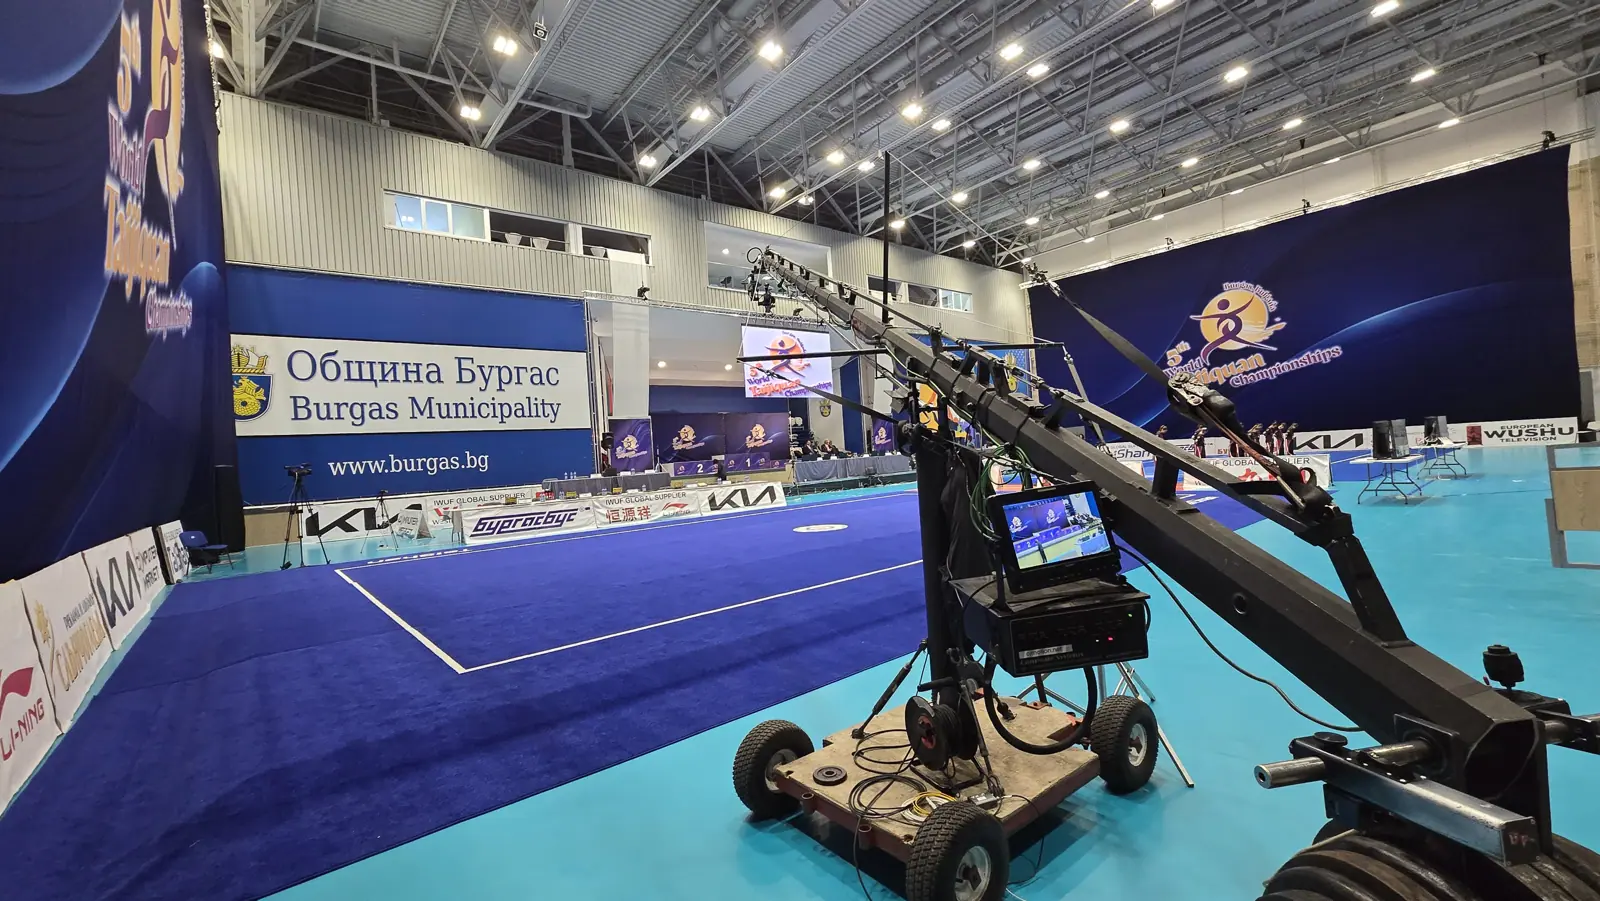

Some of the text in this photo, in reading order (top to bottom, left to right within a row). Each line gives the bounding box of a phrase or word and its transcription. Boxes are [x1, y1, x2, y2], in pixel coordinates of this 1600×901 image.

[108, 98, 144, 197] World
[1166, 341, 1191, 367] 5th
[287, 349, 560, 392] Община Бургас
[1230, 345, 1343, 388] Championships
[747, 375, 770, 386] World
[290, 395, 561, 427] Burgas Municipality
[1484, 427, 1575, 438] WUSHU
[328, 451, 489, 475] www.burgas.bg
[697, 464, 704, 473] 2
[745, 458, 751, 467] 1
[456, 495, 488, 504] GLOBAL
[489, 492, 526, 501] SUPPLIER
[606, 492, 687, 506] IWUF GLOBAL SUPPLIER
[708, 486, 777, 511] KIA
[606, 504, 652, 523] 恒源祥
[0, 698, 44, 761] LI-NING
